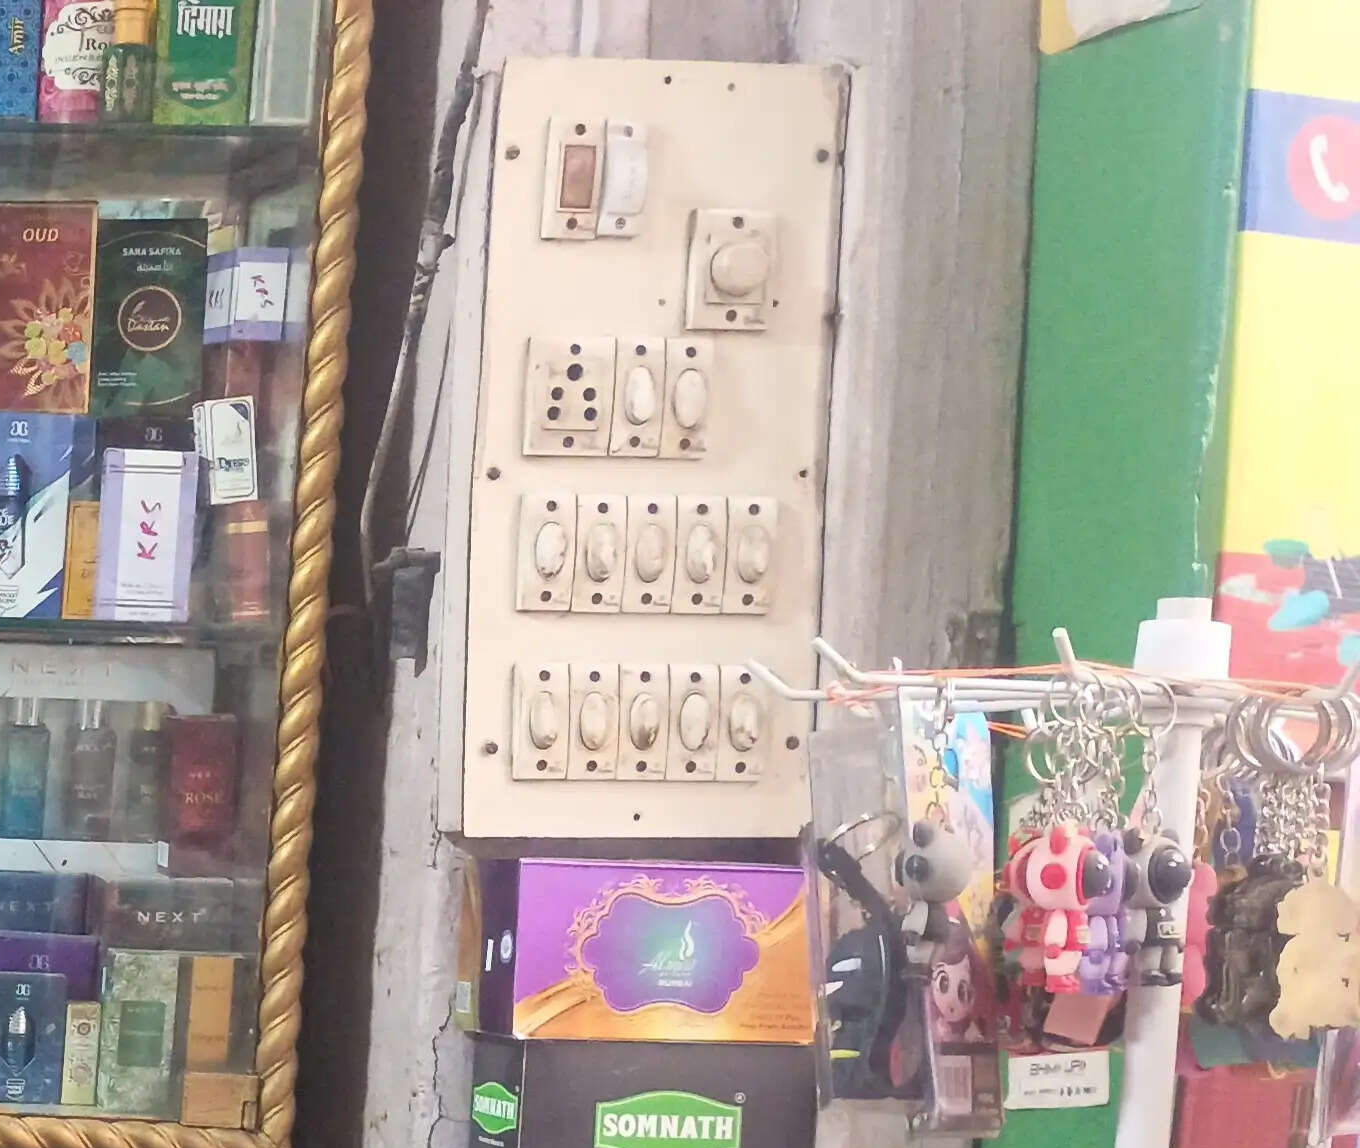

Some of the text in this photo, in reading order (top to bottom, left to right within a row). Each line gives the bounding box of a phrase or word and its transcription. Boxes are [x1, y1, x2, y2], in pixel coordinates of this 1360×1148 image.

[21, 227, 60, 243] OUD
[136, 499, 162, 561] KRS
[136, 910, 203, 924] NEXT
[475, 1093, 515, 1120] SOMNATH
[602, 1113, 734, 1140] SOMNATH
